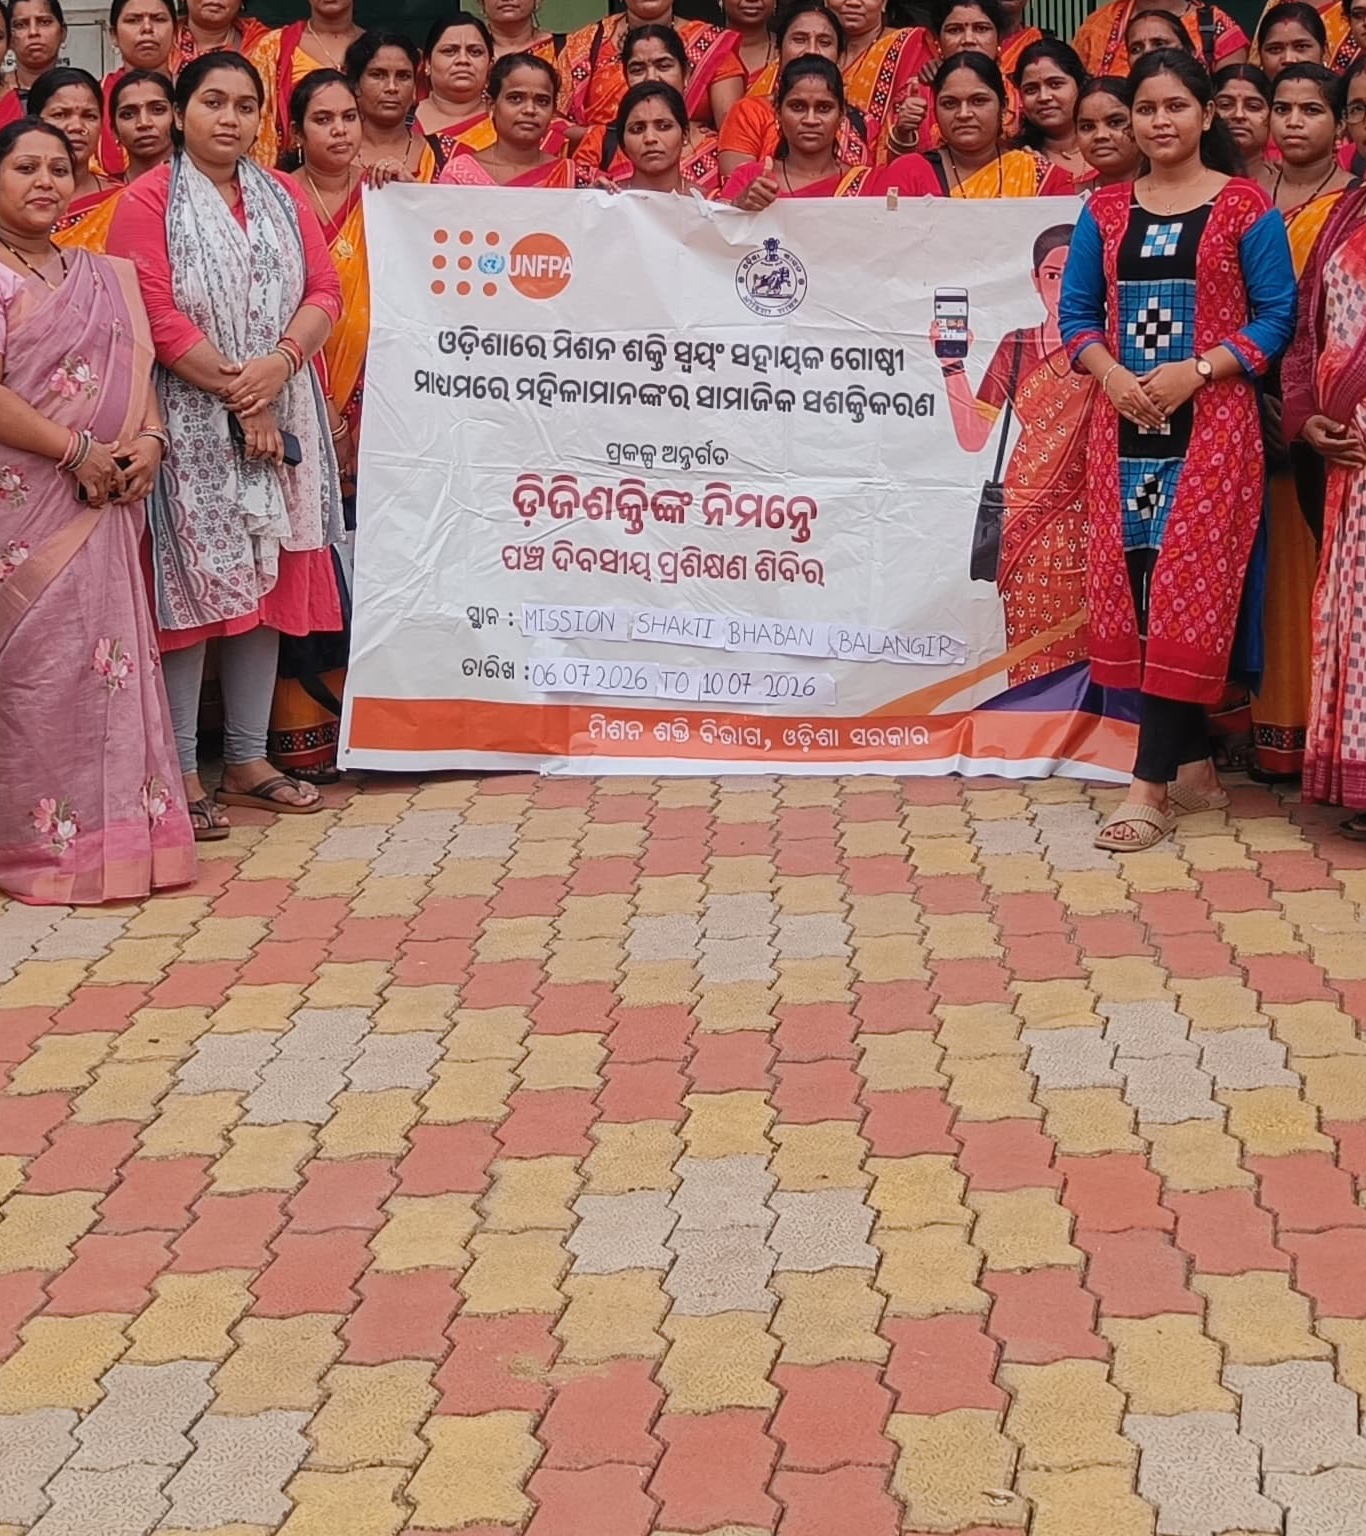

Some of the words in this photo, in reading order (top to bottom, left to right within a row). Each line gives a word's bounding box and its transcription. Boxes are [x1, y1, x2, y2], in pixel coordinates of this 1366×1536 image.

[507, 254, 573, 279] UNFPA
[438, 325, 547, 361] ଓଡ଼ିଶାରେ
[553, 329, 615, 361] ମିଶନ
[622, 333, 667, 372] ଶକ୍ତି
[731, 343, 823, 375] ସହାୟକ
[831, 346, 904, 376] ଗୋଷ୍ଠୀ
[515, 372, 689, 410] ମହିଳାମାନଙ୍କର
[696, 382, 795, 412] ସାମାଜିକ
[803, 384, 935, 424] ସଶକ୍ତିକରଣ
[662, 440, 729, 470] ଅନ୍ତର୍ଗତ
[702, 481, 818, 543] ନିମନ୍ତେ
[551, 539, 652, 581] ଦିବସୀୟ
[657, 545, 747, 583] ପ୍ରଶିକ୍ଷଣ
[755, 549, 825, 587] ଶିବିର
[524, 608, 615, 633] MISSION
[636, 612, 716, 639] SHAKTI
[728, 621, 814, 646] BHABAN
[838, 630, 955, 657] BALANGIR
[661, 671, 689, 694] TO
[588, 714, 643, 741] ମିଶନ
[653, 718, 690, 743] ଶକ୍ତି
[699, 720, 772, 751] ବିଭାଗ,
[782, 723, 839, 752] ଓଡ଼ିଶା
[849, 725, 929, 746] ସରକାର
